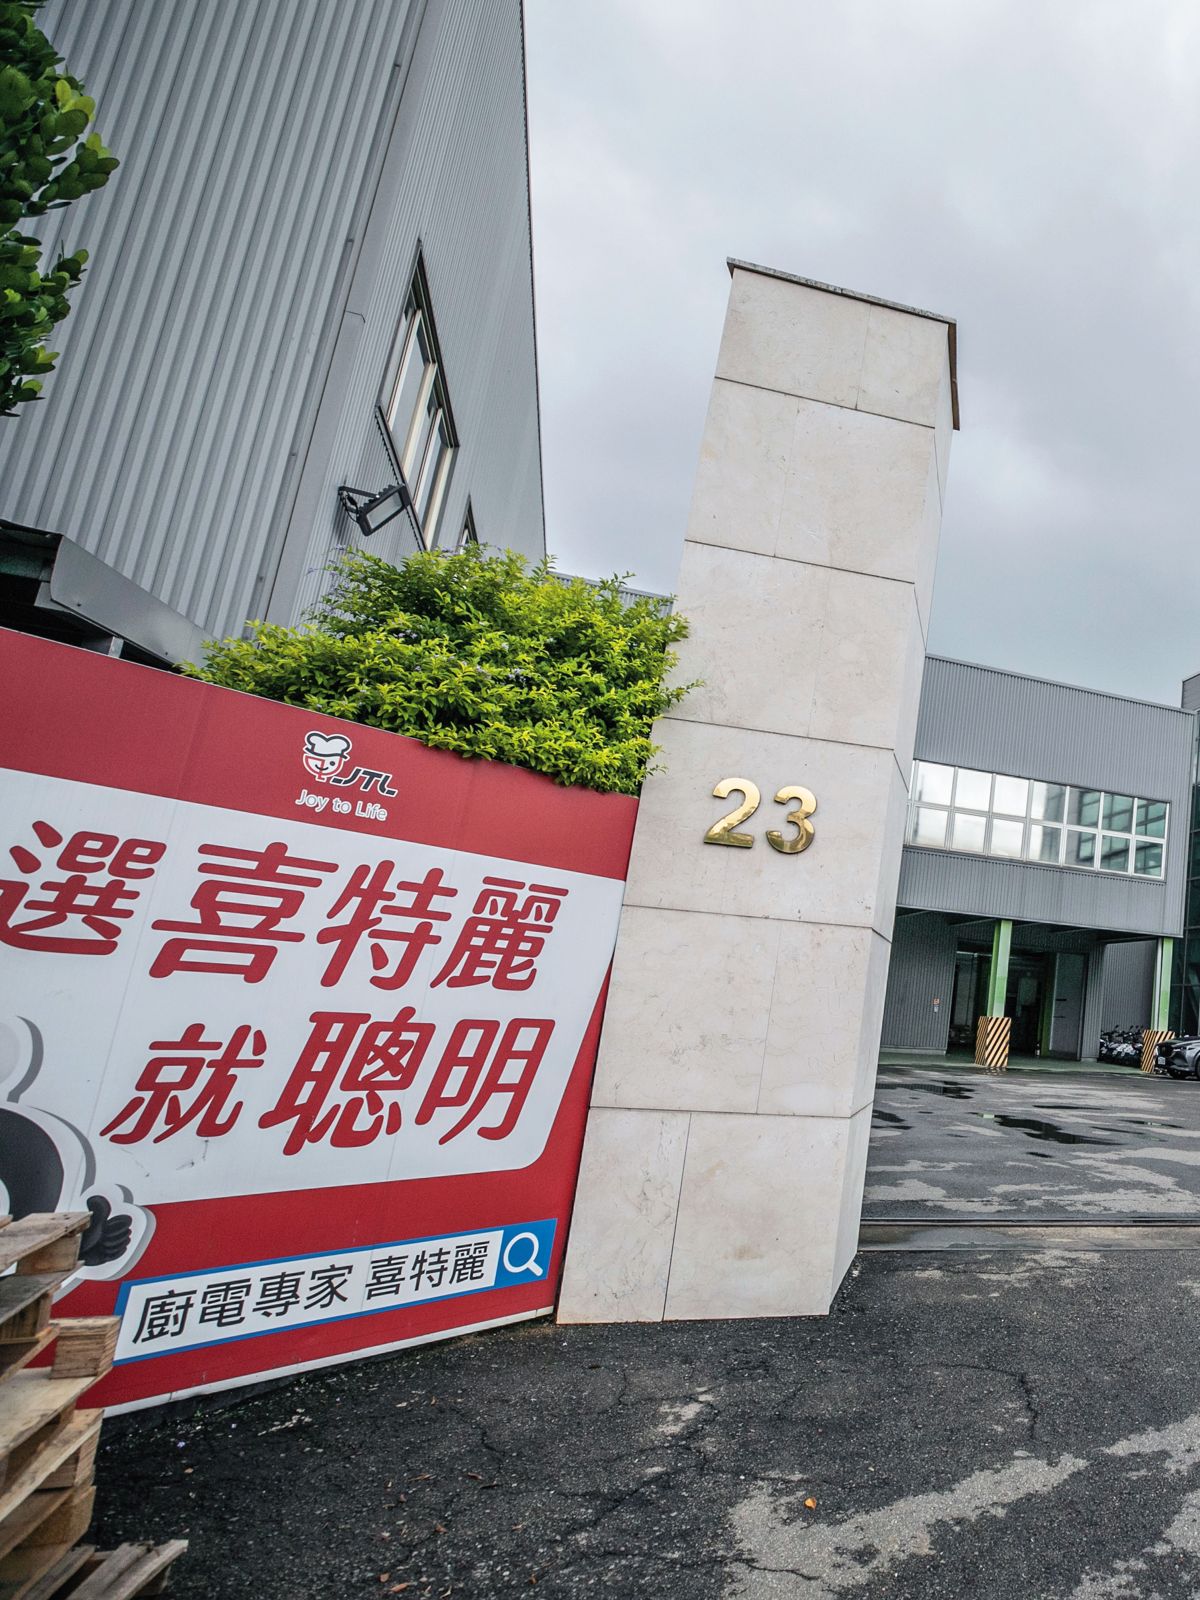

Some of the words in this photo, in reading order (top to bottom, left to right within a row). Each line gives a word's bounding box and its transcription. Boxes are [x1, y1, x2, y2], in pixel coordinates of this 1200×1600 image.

[295, 789, 329, 812] Joy
[332, 797, 352, 814] to
[355, 801, 388, 821] Life
[330, 767, 398, 797] JTL
[703, 777, 818, 854] 23
[0, 820, 570, 992] 選喜特麗
[100, 1006, 556, 1156] 就聰明
[132, 1264, 354, 1344] 廚電專家
[365, 1240, 491, 1301] 喜特麗
